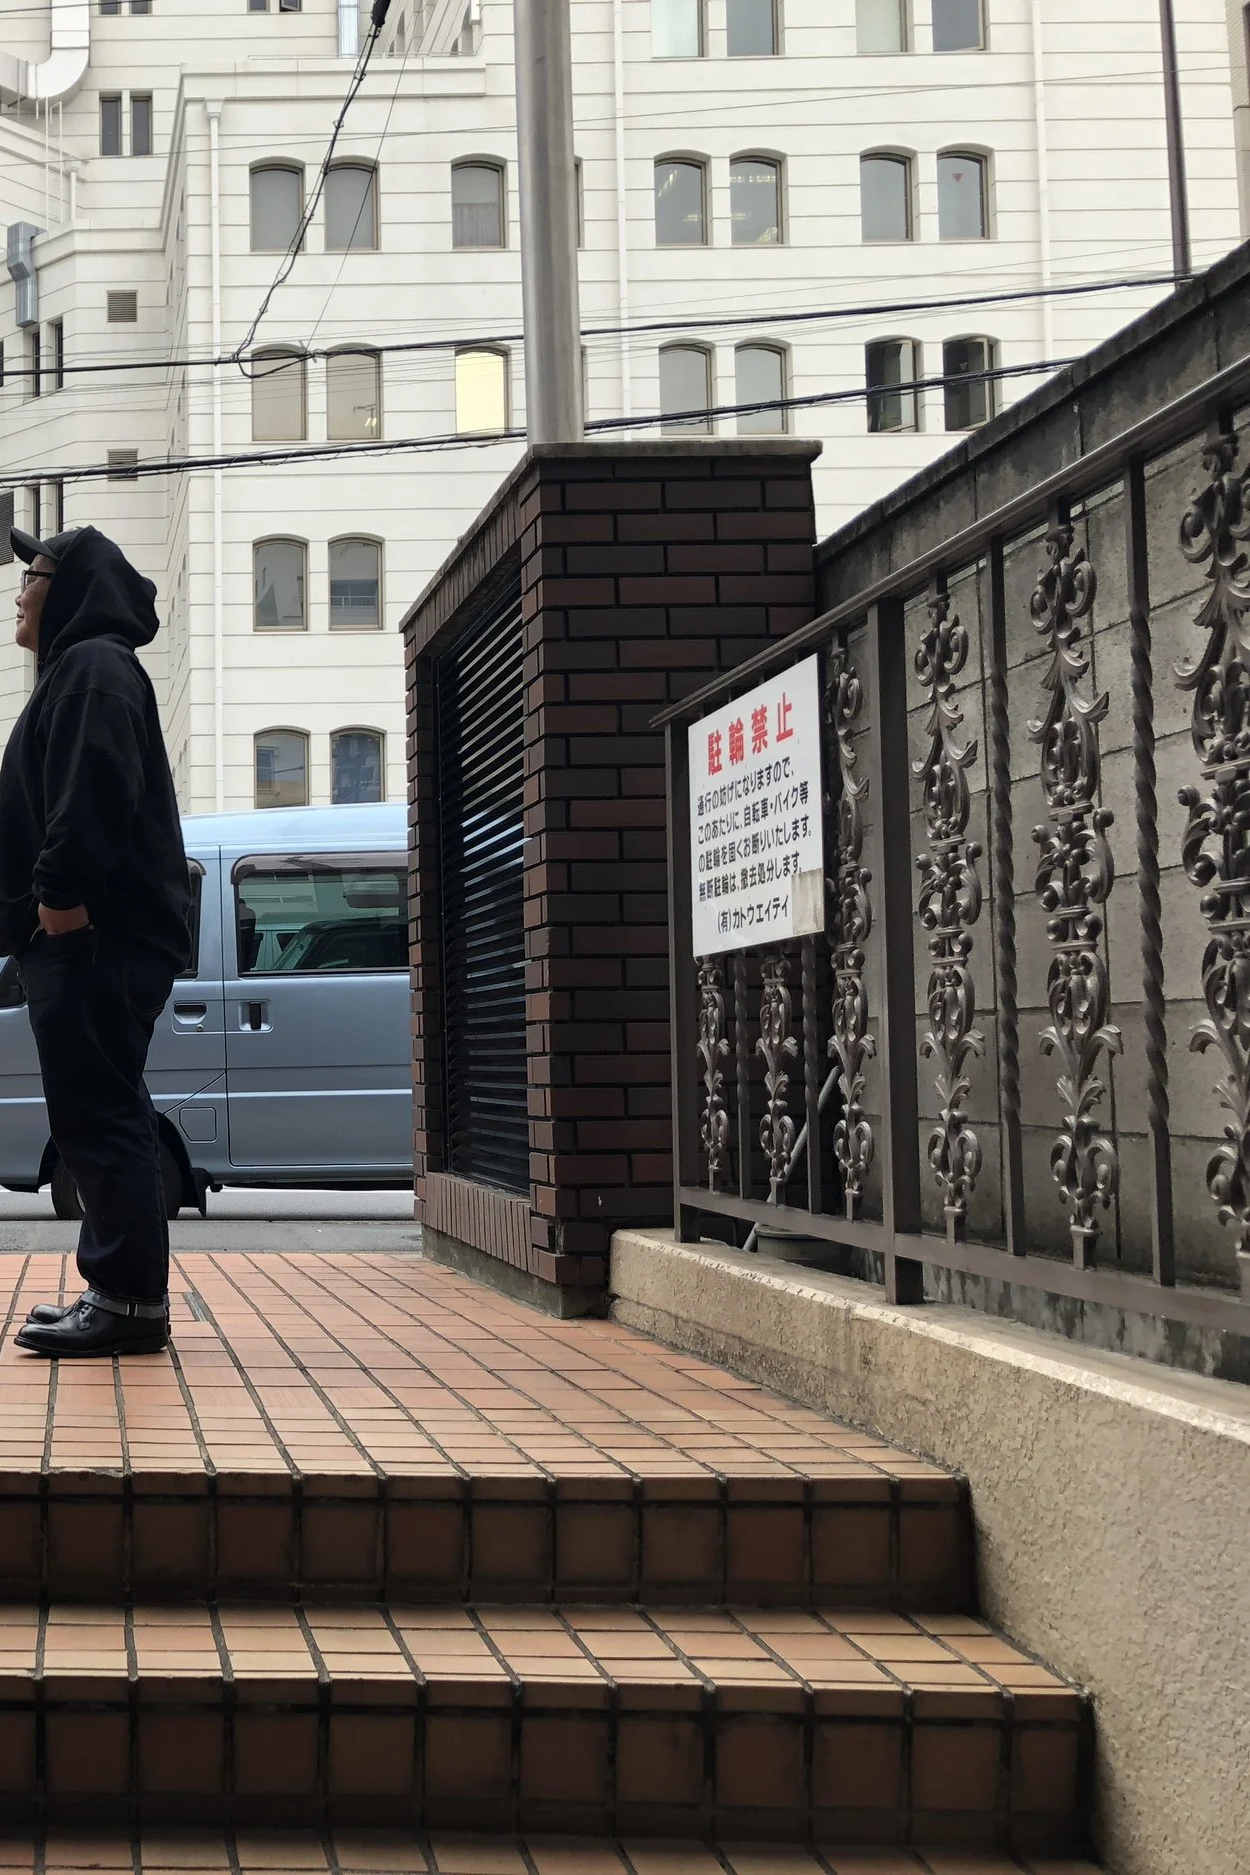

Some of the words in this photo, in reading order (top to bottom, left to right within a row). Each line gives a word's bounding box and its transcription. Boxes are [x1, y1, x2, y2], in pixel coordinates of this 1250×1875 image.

[707, 691, 794, 776] 駐輪禁止
[697, 755, 795, 817] 通行の妨げになりますので、
[697, 780, 809, 845] このあたりに、自転車・バイク等
[698, 813, 812, 873] の駐輪を固くお断りいたします。
